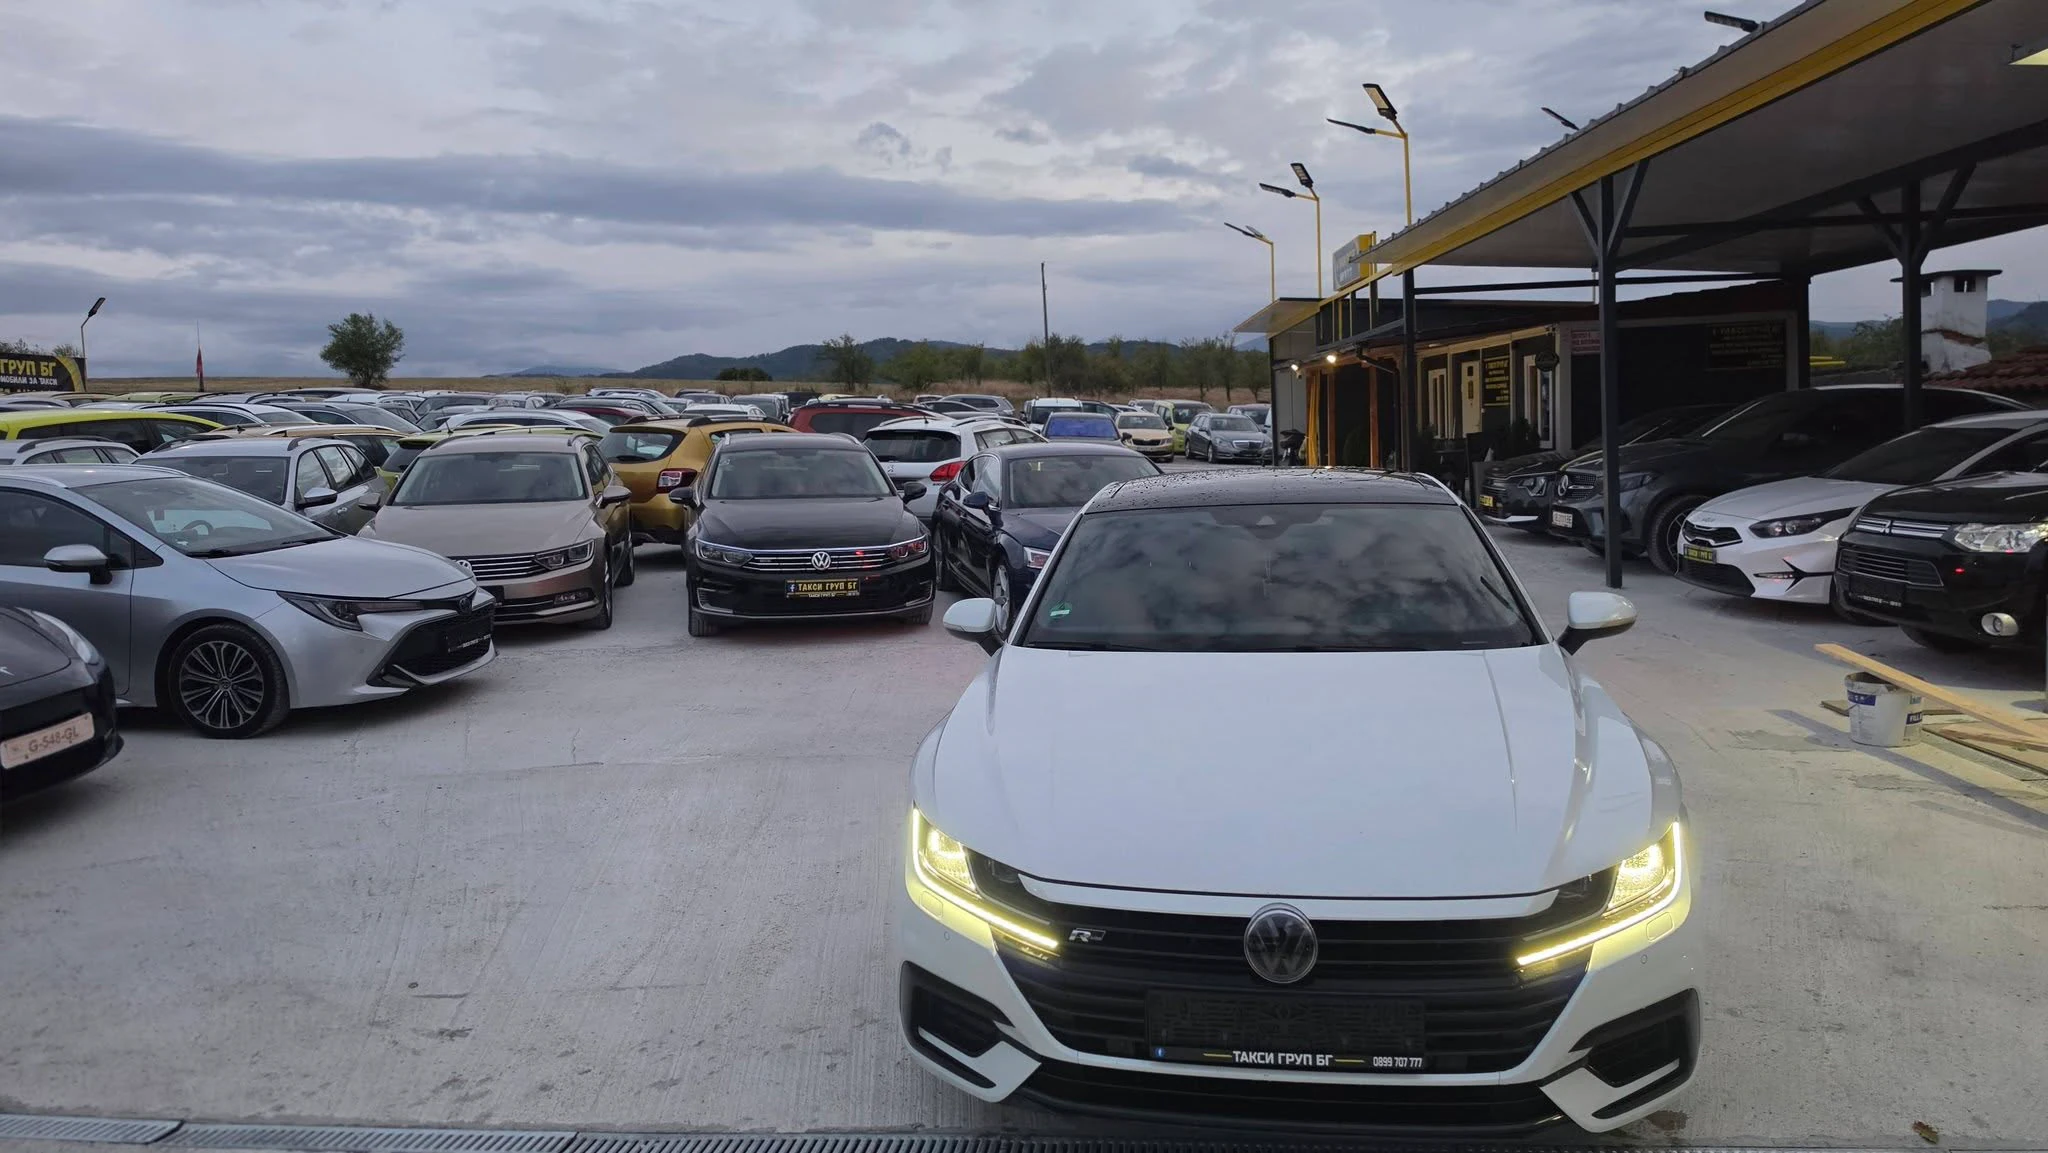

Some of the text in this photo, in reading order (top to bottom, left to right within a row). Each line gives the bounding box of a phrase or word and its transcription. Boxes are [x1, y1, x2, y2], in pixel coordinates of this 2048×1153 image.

[0, 359, 57, 377] ГРУП БГ
[798, 582, 857, 592] ТАКСИ ГРУП БГ
[28, 725, 79, 752] G-548-GL
[1232, 1050, 1334, 1067] ТАКСИ ГРУП БГ
[1372, 1056, 1423, 1068] 0899 707 777
